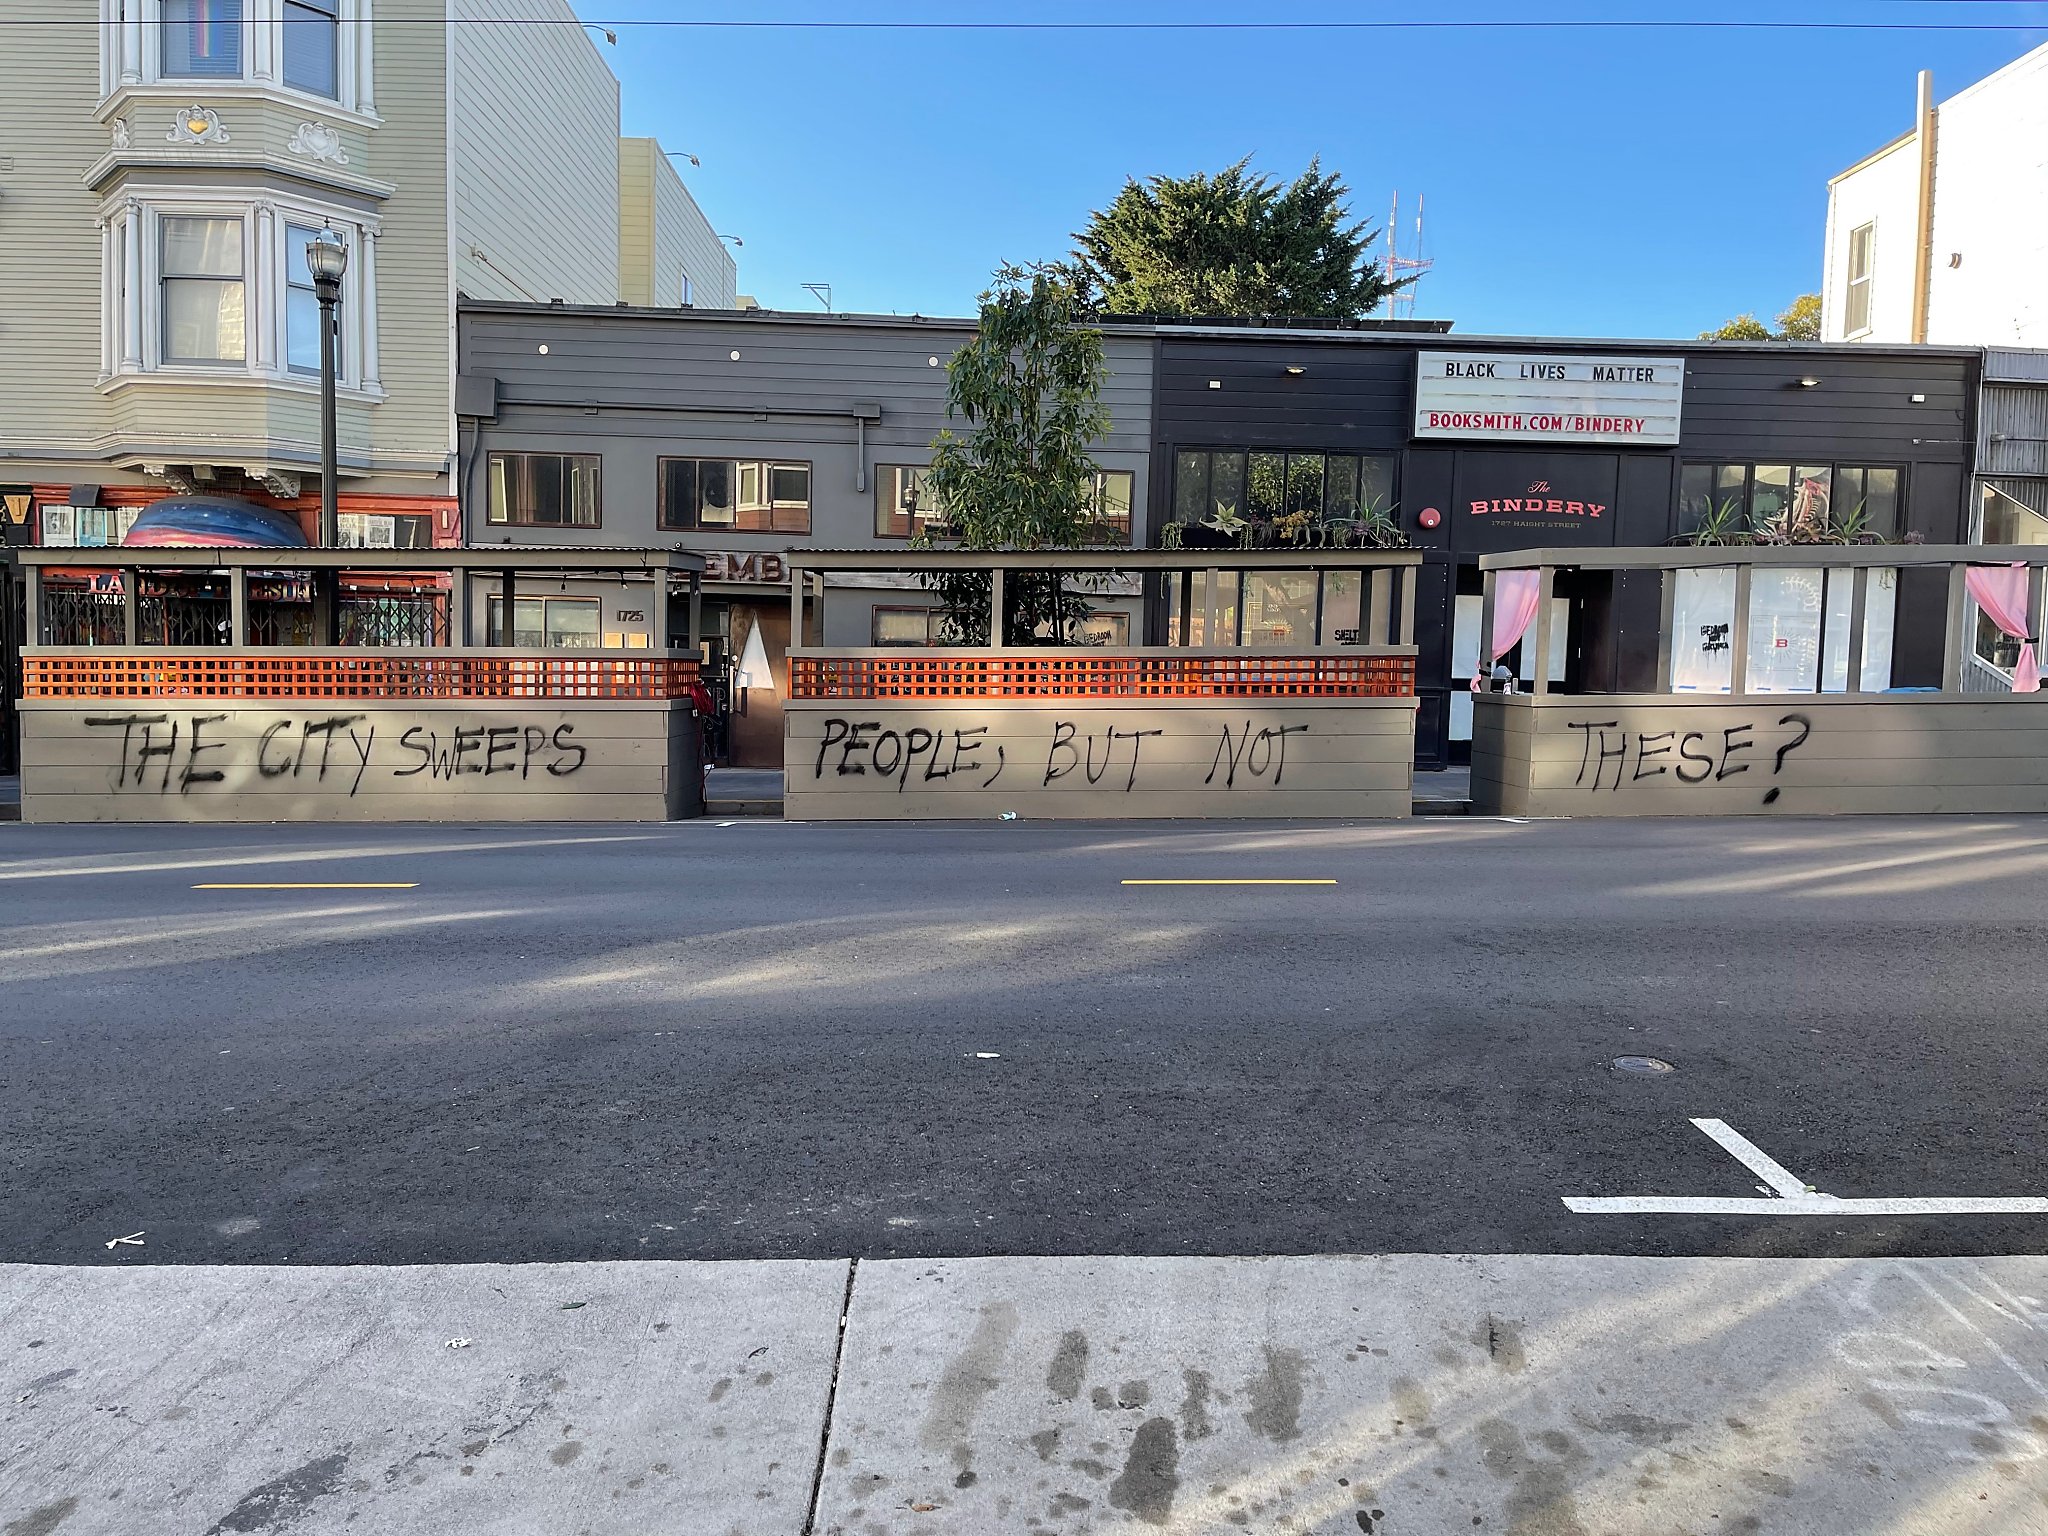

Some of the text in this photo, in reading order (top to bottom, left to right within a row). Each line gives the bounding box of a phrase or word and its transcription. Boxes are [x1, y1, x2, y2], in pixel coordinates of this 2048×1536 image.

[1445, 362, 1654, 382] BLACK LIVES MATTER
[1429, 413, 1645, 433] BOOKSMITH.COM/BINDERY
[1527, 480, 1551, 493] The
[1470, 498, 1606, 518] BINDERY
[1491, 519, 1511, 527] 1727
[616, 610, 644, 622] 1725
[1776, 639, 1788, 647] B
[84, 714, 586, 797] THE CITY SWEEPS
[815, 718, 1309, 793] PEOPLE, BUT NOT
[1567, 714, 1811, 804] THESE?
